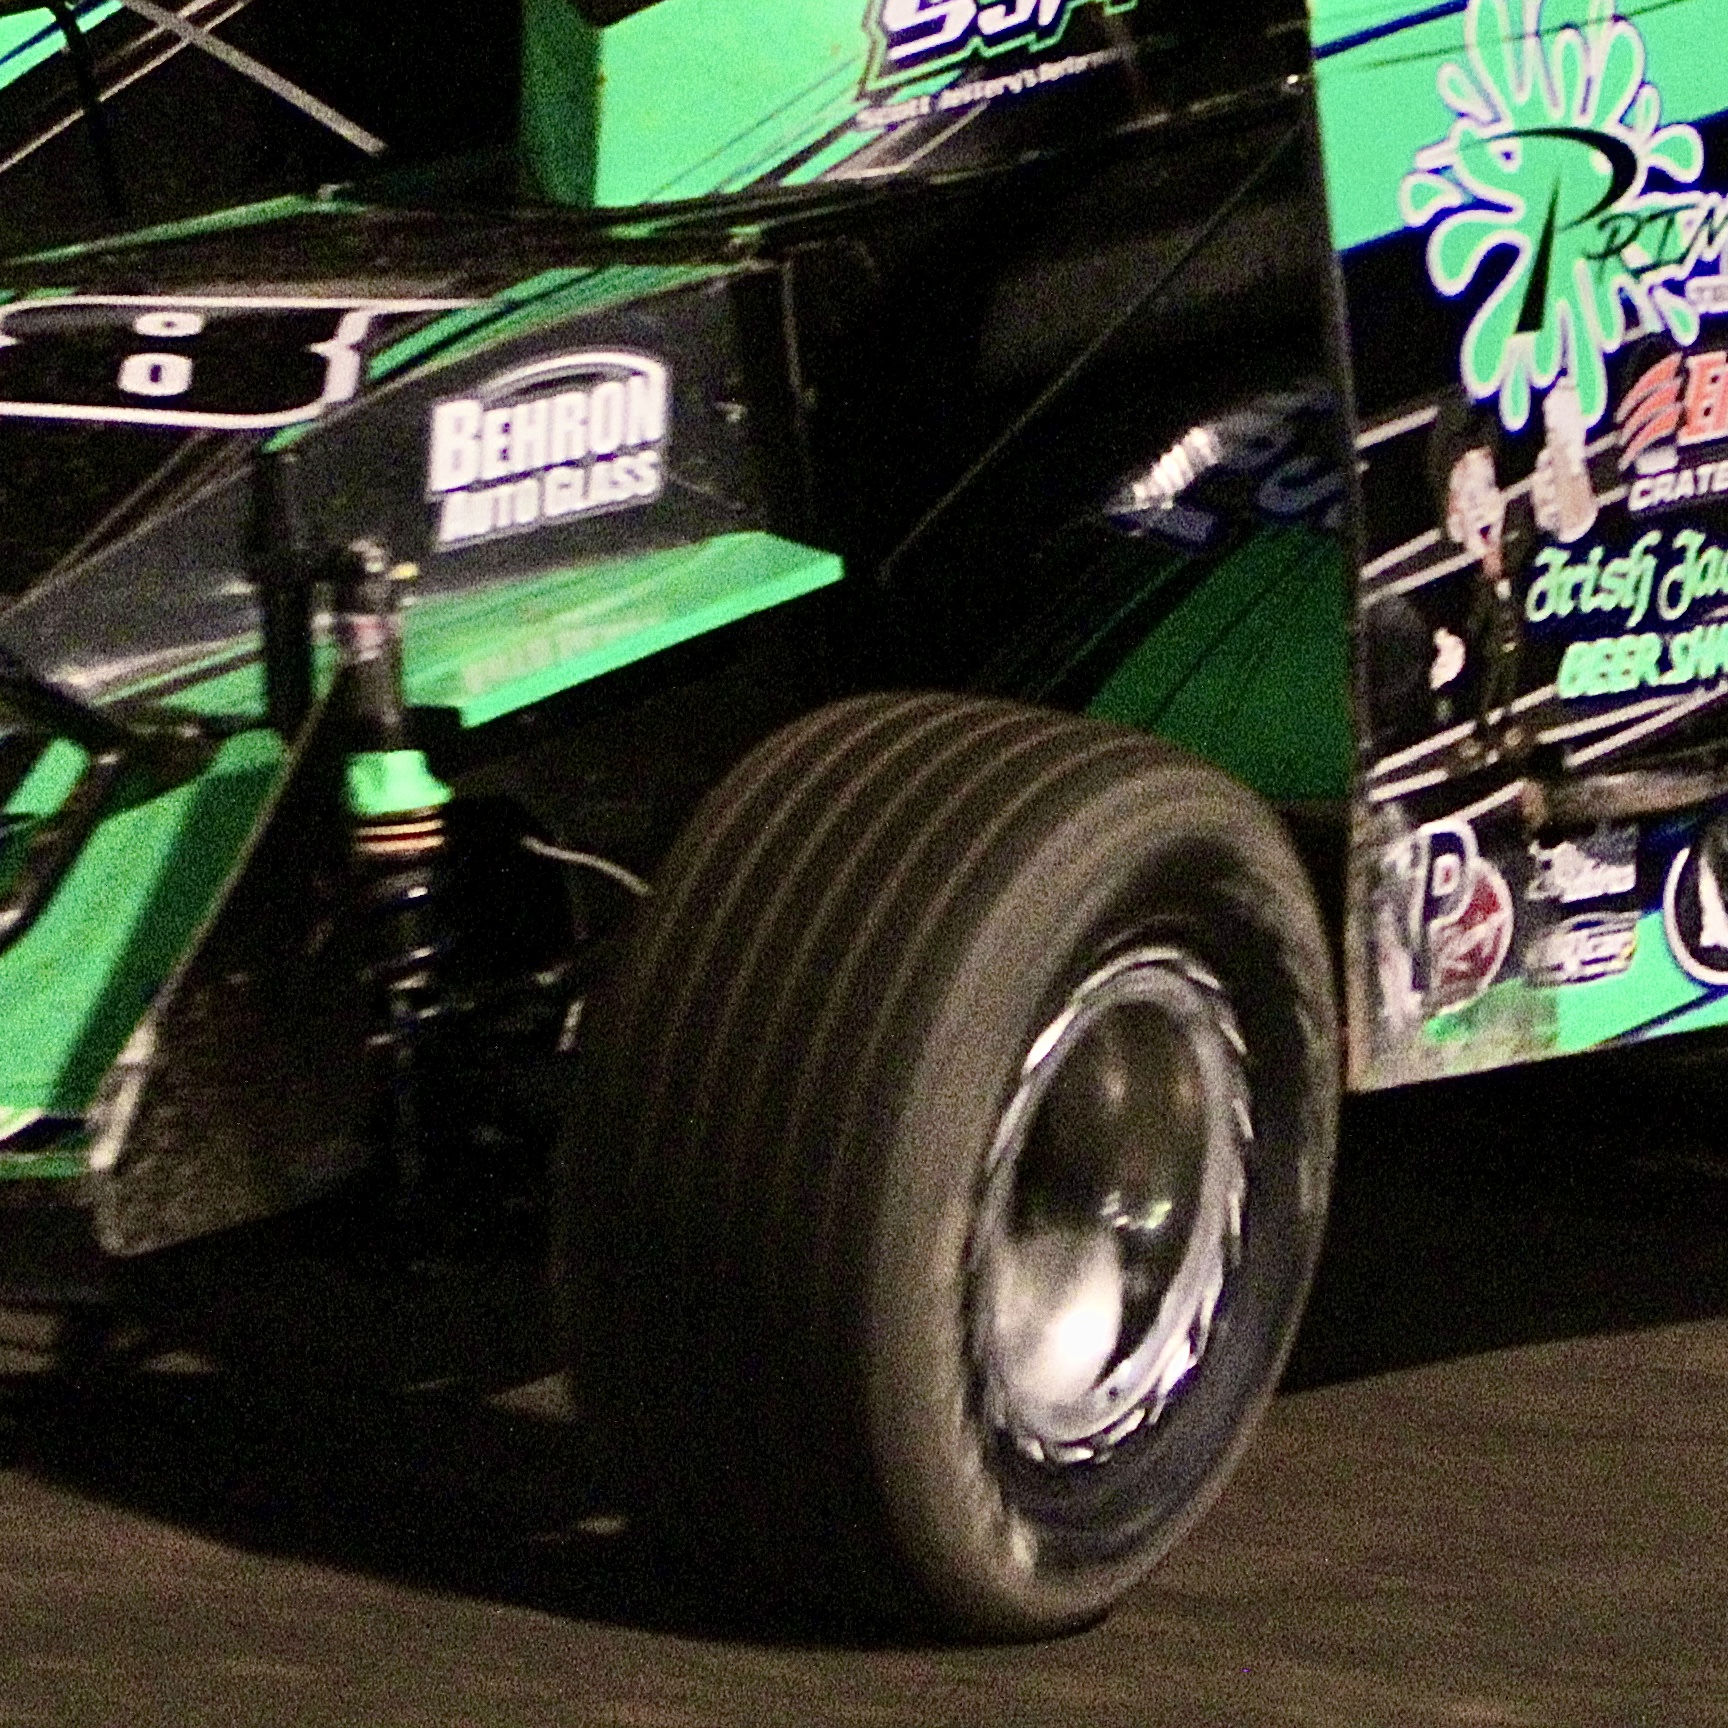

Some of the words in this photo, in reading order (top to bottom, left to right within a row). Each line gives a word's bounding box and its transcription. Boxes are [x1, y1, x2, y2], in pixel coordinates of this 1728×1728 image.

[430, 374, 668, 493] BEHRON
[438, 475, 542, 543] AUTO
[540, 450, 663, 519] GLASS
[1524, 528, 1664, 629] Irish
[1557, 630, 1664, 700] BEER
